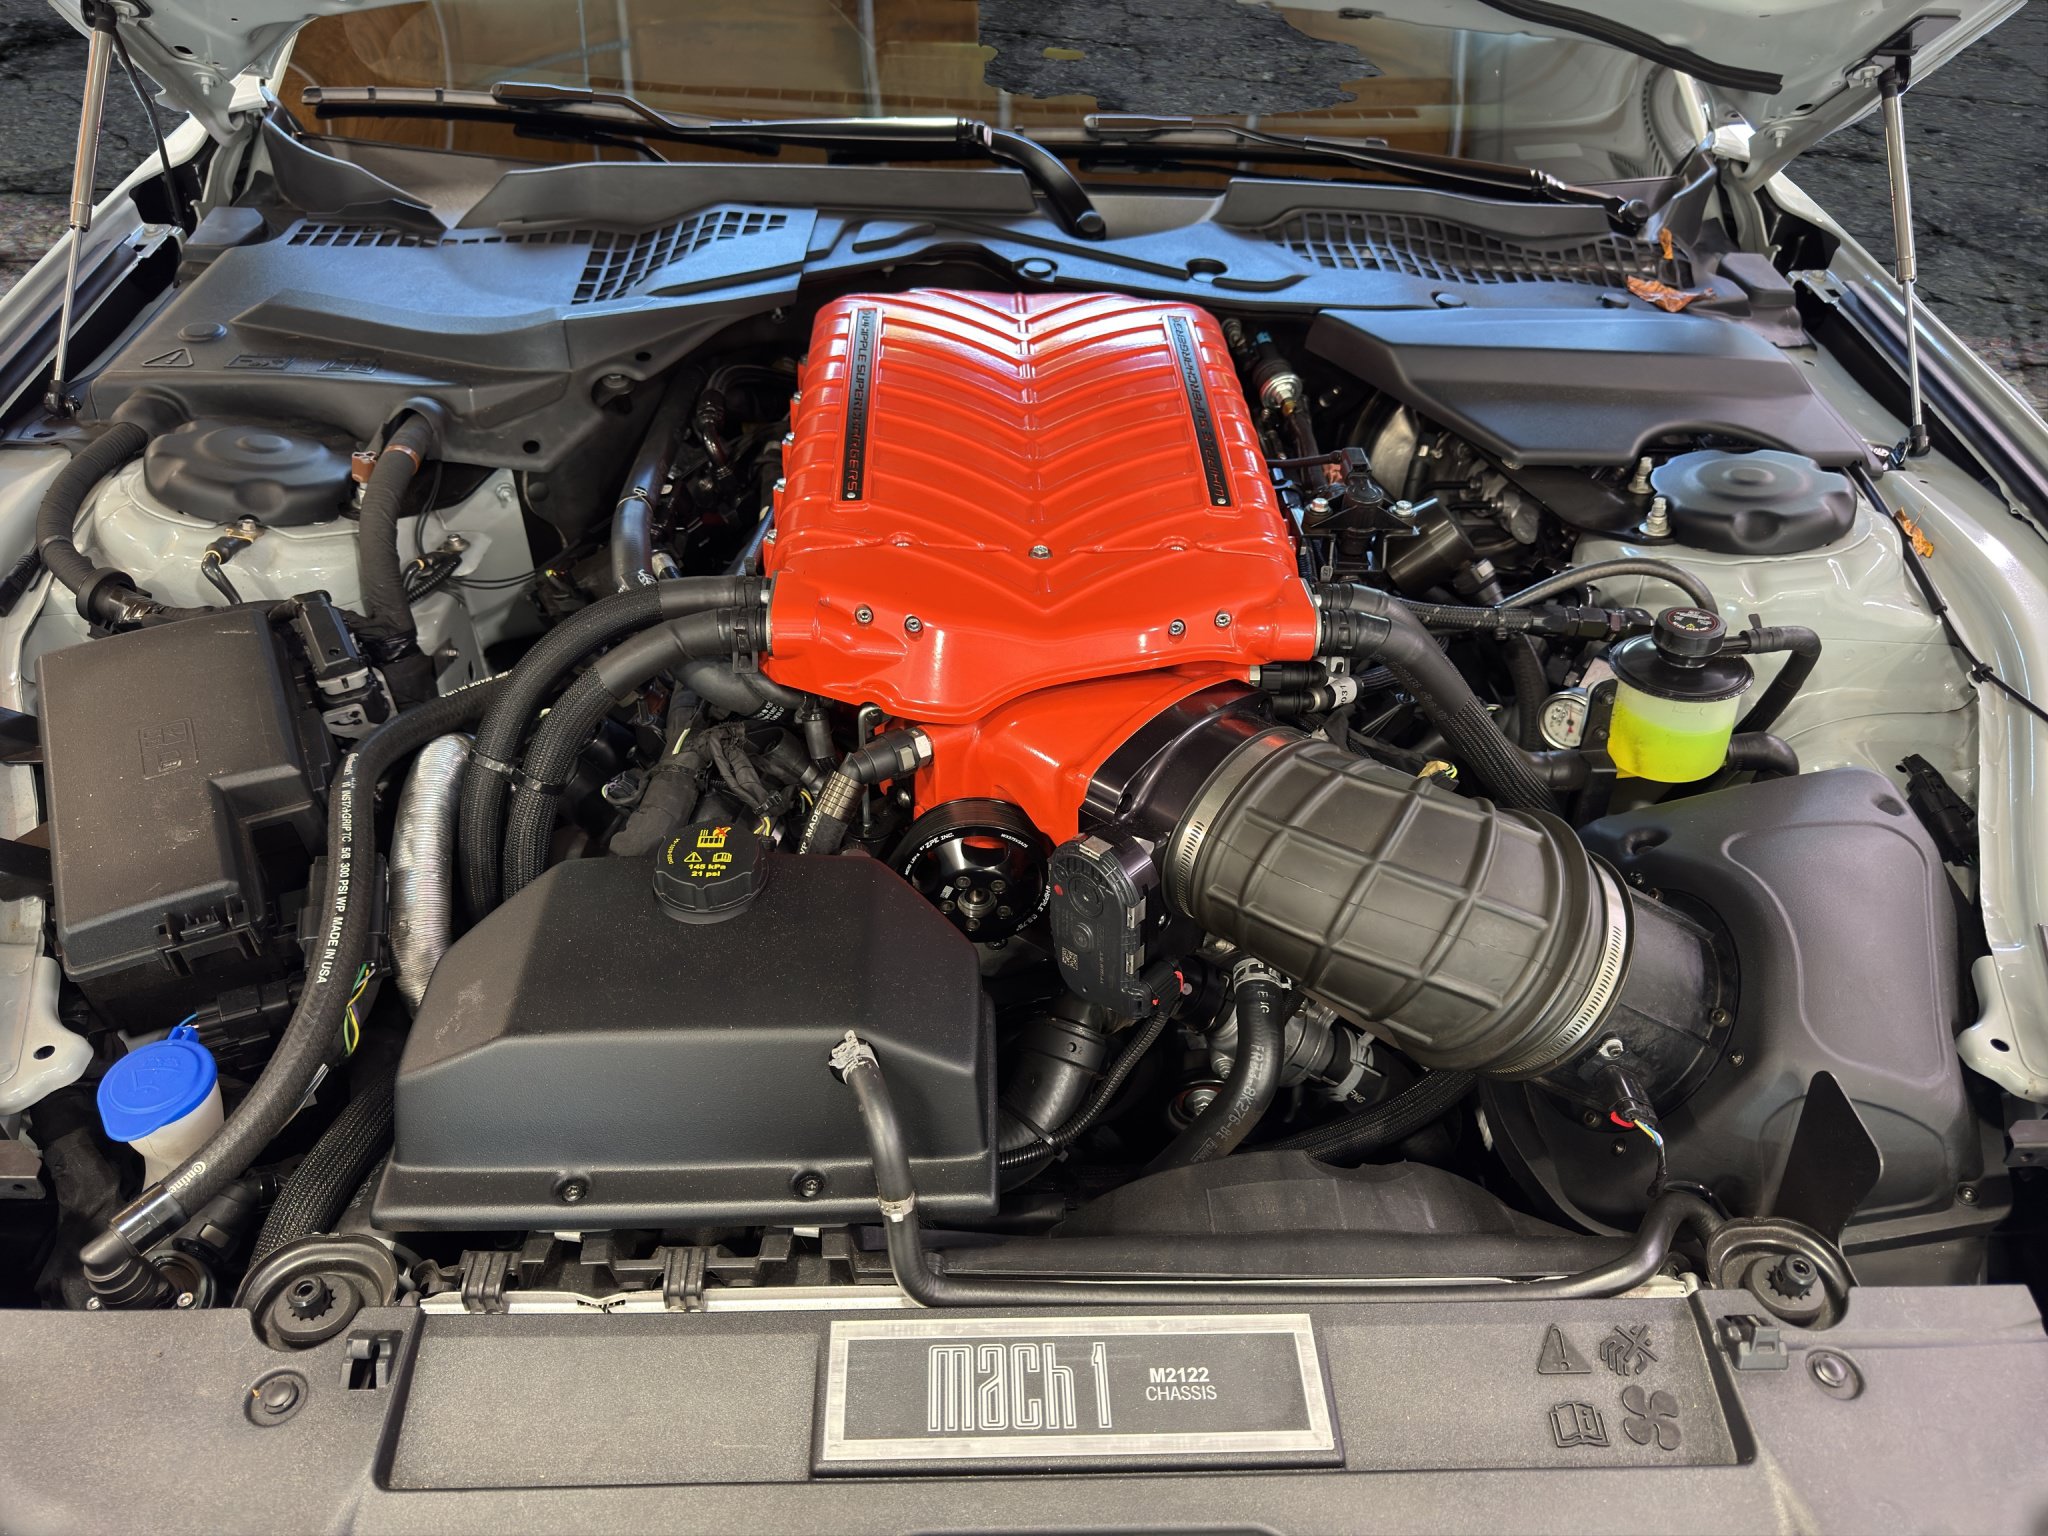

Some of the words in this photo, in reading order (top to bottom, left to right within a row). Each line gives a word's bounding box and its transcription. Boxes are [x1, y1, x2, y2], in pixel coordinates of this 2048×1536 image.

[1173, 322, 1209, 428] SUPERCHARGERS
[847, 364, 866, 491] SUPERCHARGERS
[1202, 432, 1225, 497] WHIPPLE
[805, 809, 821, 838] MADE
[924, 836, 940, 849] ZPE
[341, 846, 351, 860] 5/8
[339, 862, 351, 878] 300
[705, 870, 721, 878] psi
[337, 879, 349, 895] PSI
[335, 895, 347, 913] WP
[327, 916, 344, 947] MADE
[323, 948, 337, 960] IN
[316, 961, 333, 984] USA
[1149, 1366, 1210, 1383] M2122
[1091, 1341, 1113, 1429] 1
[1145, 1385, 1218, 1401] CHASSIS
